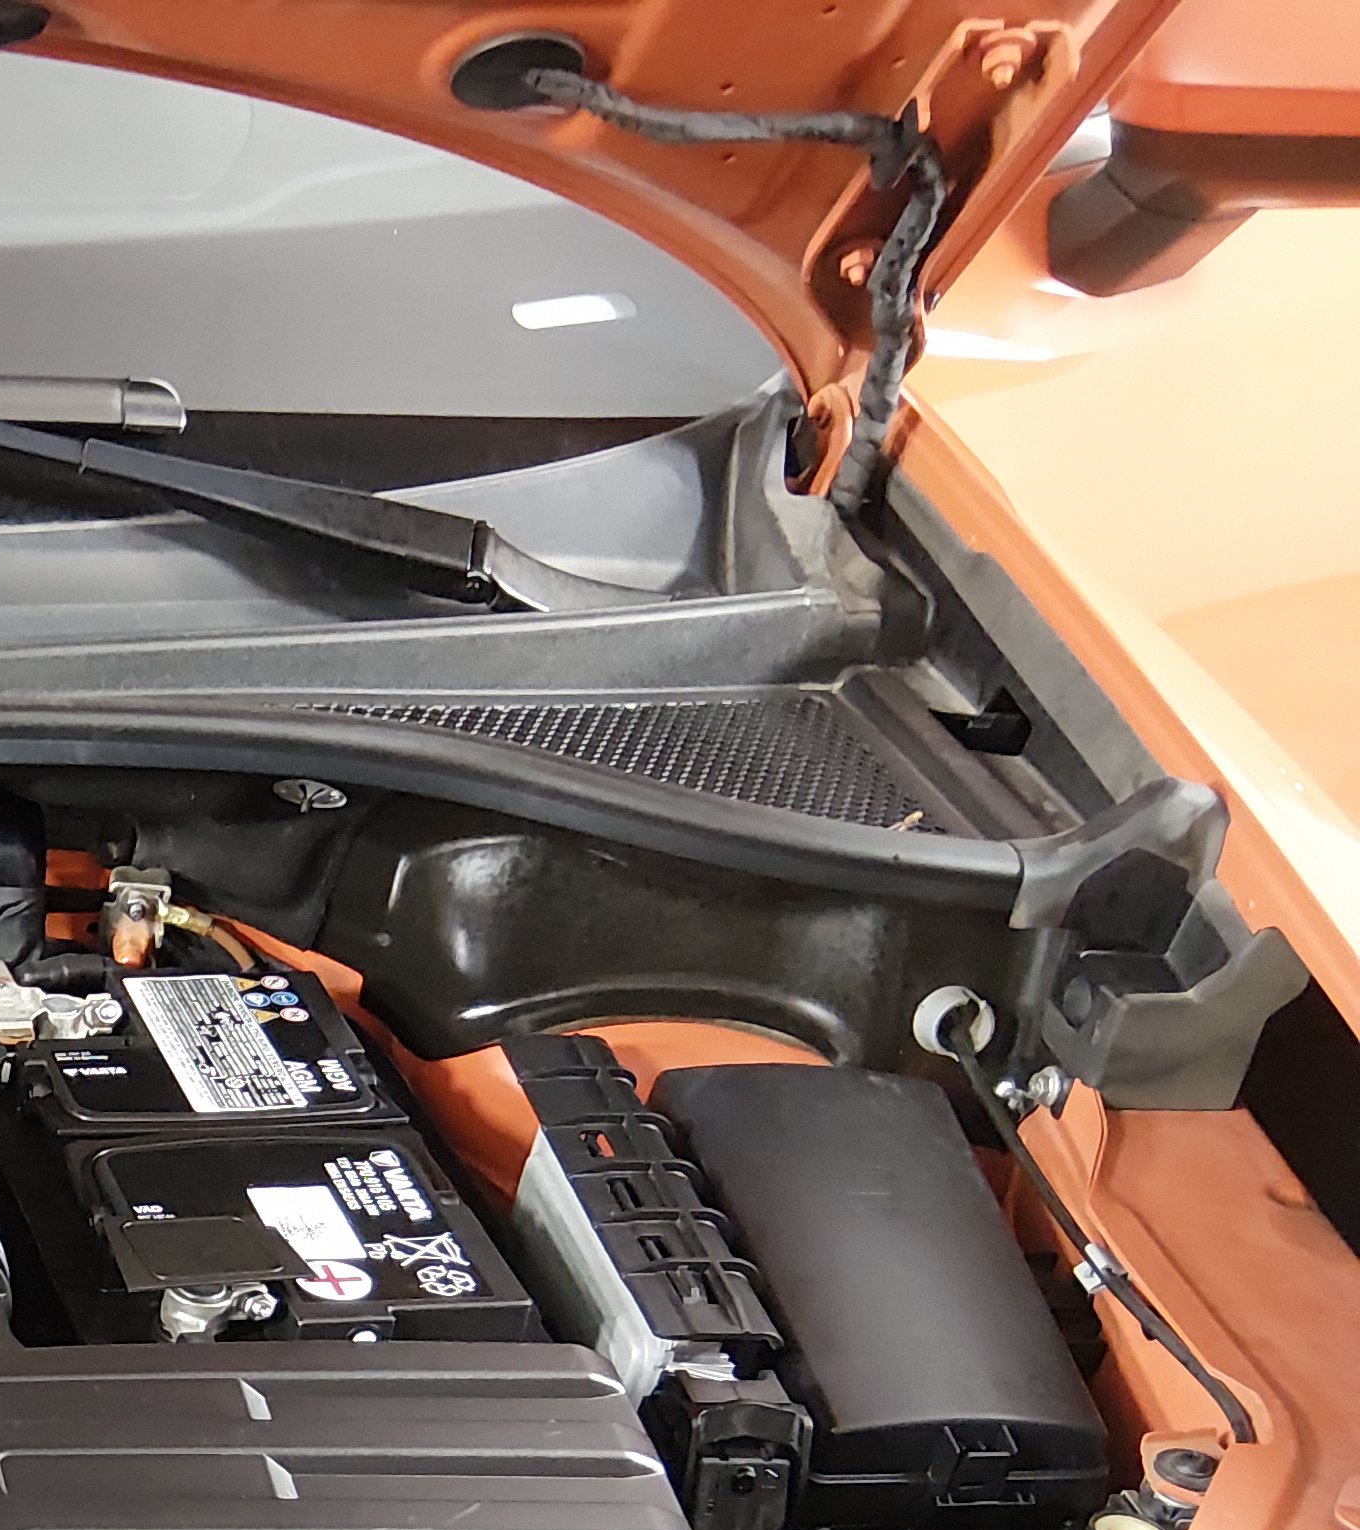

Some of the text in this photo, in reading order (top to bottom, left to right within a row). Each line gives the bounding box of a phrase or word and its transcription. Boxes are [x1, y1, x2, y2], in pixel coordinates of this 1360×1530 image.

[282, 1061, 323, 1092] AGM
[316, 1059, 357, 1092] AGM
[382, 1167, 432, 1222] VARTA
